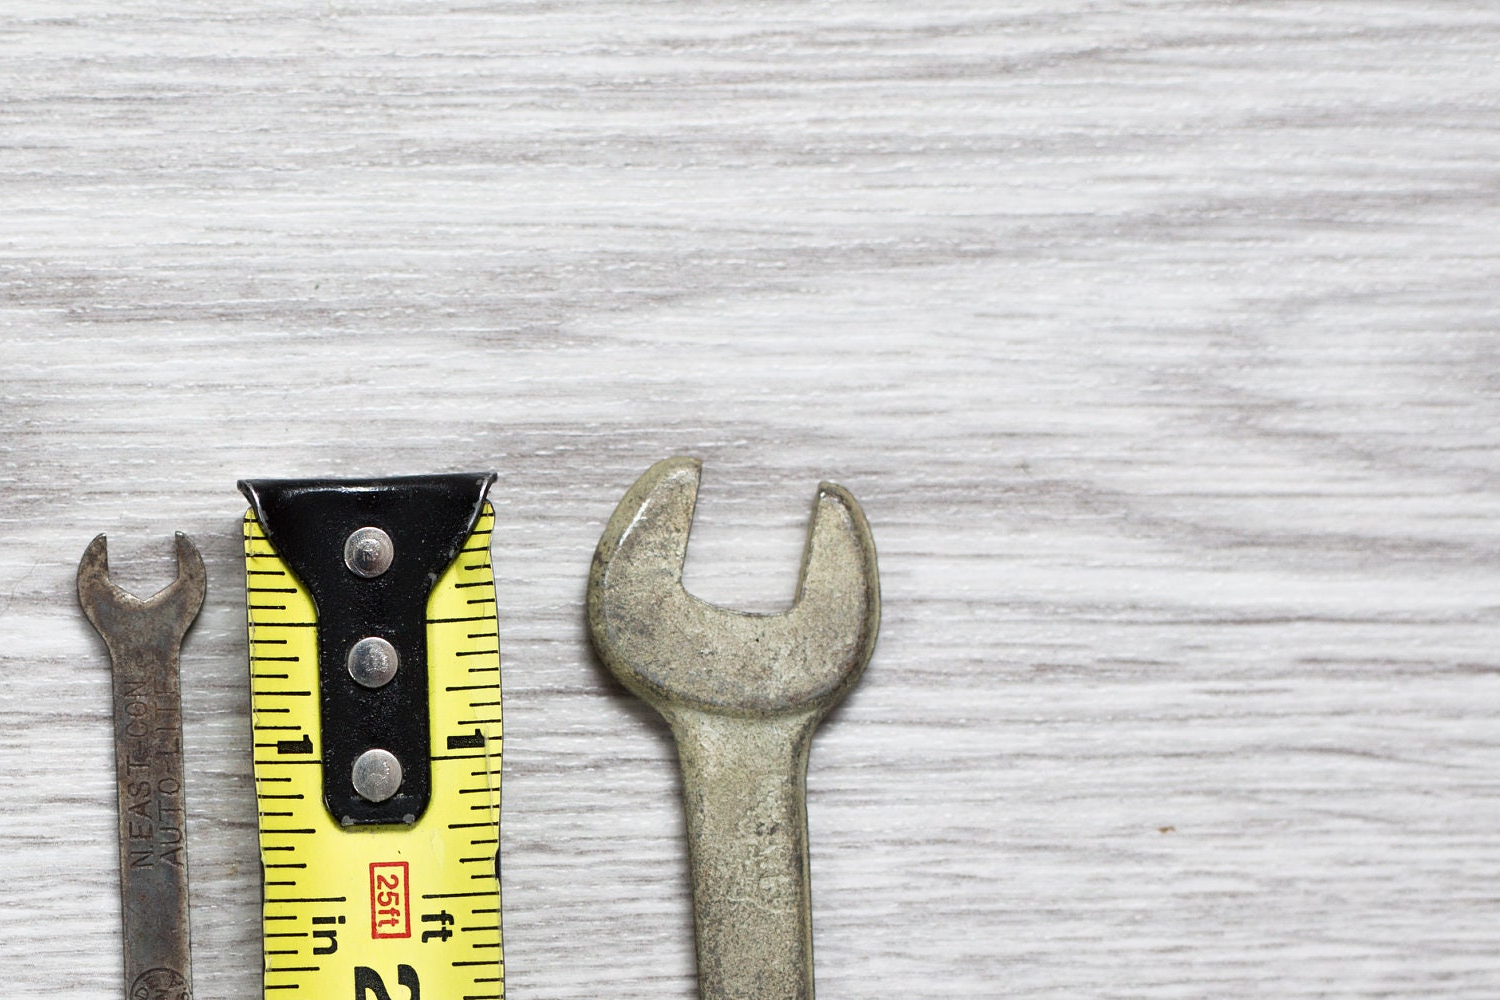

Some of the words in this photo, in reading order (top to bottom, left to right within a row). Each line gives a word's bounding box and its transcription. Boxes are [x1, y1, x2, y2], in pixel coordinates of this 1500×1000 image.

[277, 734, 314, 755] 1
[446, 728, 485, 750] 1
[376, 873, 401, 928] 25ft
[311, 915, 346, 956] in
[421, 909, 455, 944] ft
